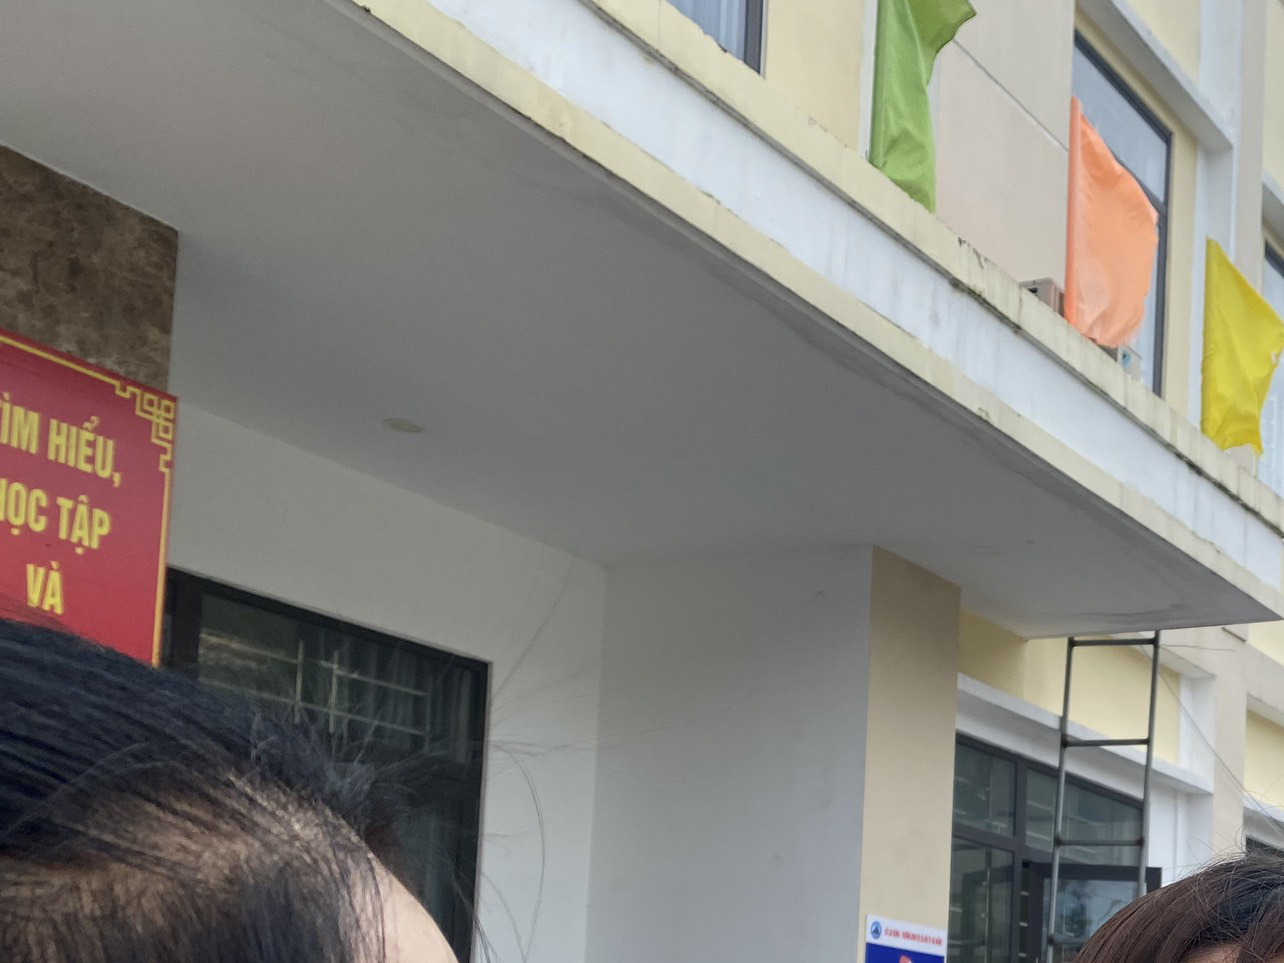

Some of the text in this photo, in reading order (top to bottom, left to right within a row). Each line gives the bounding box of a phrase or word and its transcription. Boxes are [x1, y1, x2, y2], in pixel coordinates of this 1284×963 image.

[0, 391, 122, 489] ÌM HIỂU,
[56, 494, 111, 556] TẬP
[26, 560, 64, 615] VÀ
